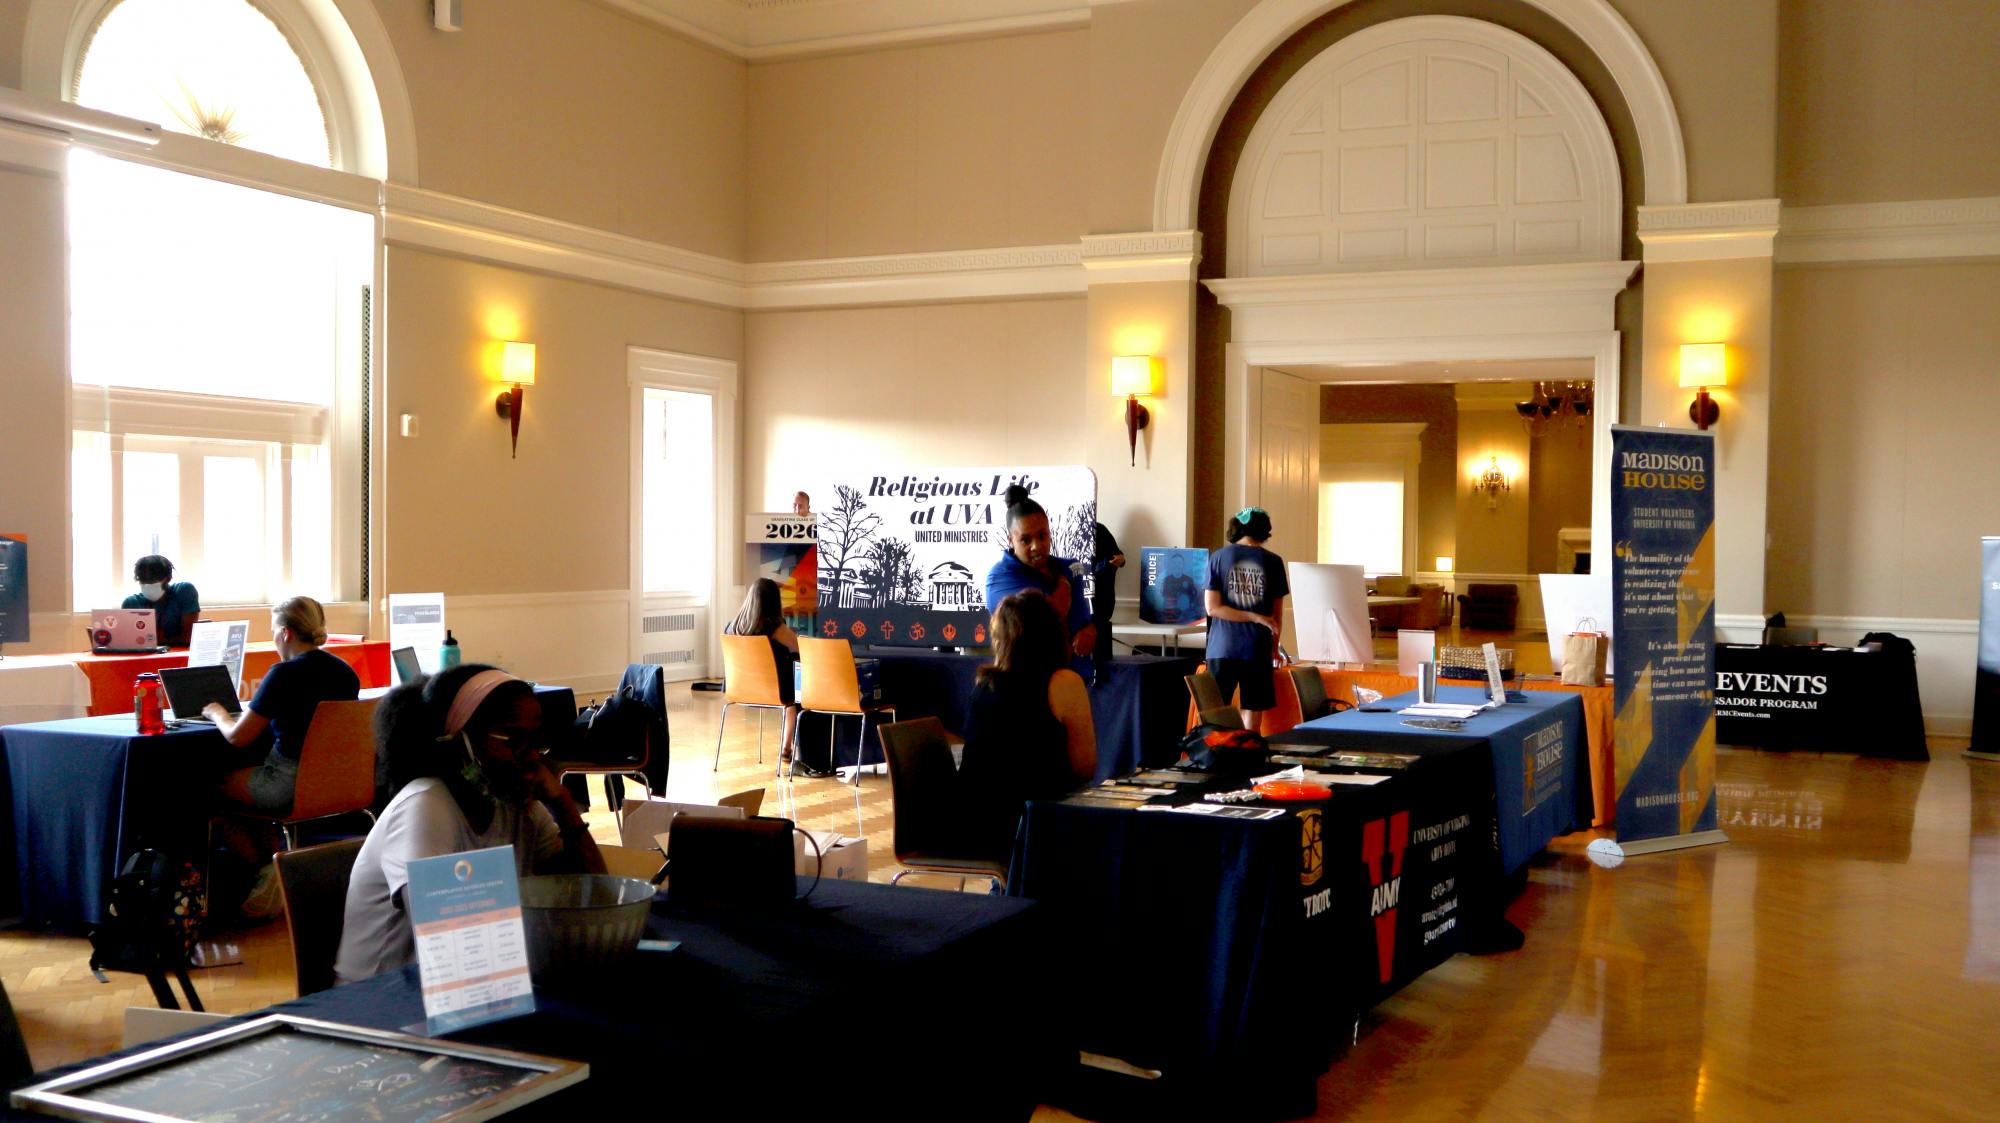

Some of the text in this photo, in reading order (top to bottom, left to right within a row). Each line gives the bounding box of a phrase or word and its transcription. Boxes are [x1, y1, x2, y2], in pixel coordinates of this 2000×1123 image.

[868, 475, 983, 503] Religious
[909, 503, 993, 525] at UVA
[1633, 507, 1695, 519] STUDENT VOLUNTEERS
[1633, 519, 1663, 529] UNIVERSITY
[766, 523, 817, 539] 2026
[915, 530, 988, 543] UNITED MINISTRIES
[1640, 554, 1672, 565] humility
[1674, 554, 1682, 562] of
[1148, 555, 1157, 586] POLICE
[1624, 566, 1699, 577] volunteer experie
[1624, 579, 1684, 589] is realizing that
[1652, 592, 1674, 601] about
[1624, 605, 1647, 616] you're
[1686, 640, 1705, 650] being
[1662, 652, 1706, 665] present and
[1634, 665, 1705, 677] rezing how much
[1652, 680, 1670, 689] time
[1686, 680, 1705, 688] mean
[1715, 672, 1827, 695] EVENTS
[1656, 693, 1689, 701] someone
[1760, 699, 1817, 710] PROGRAM
